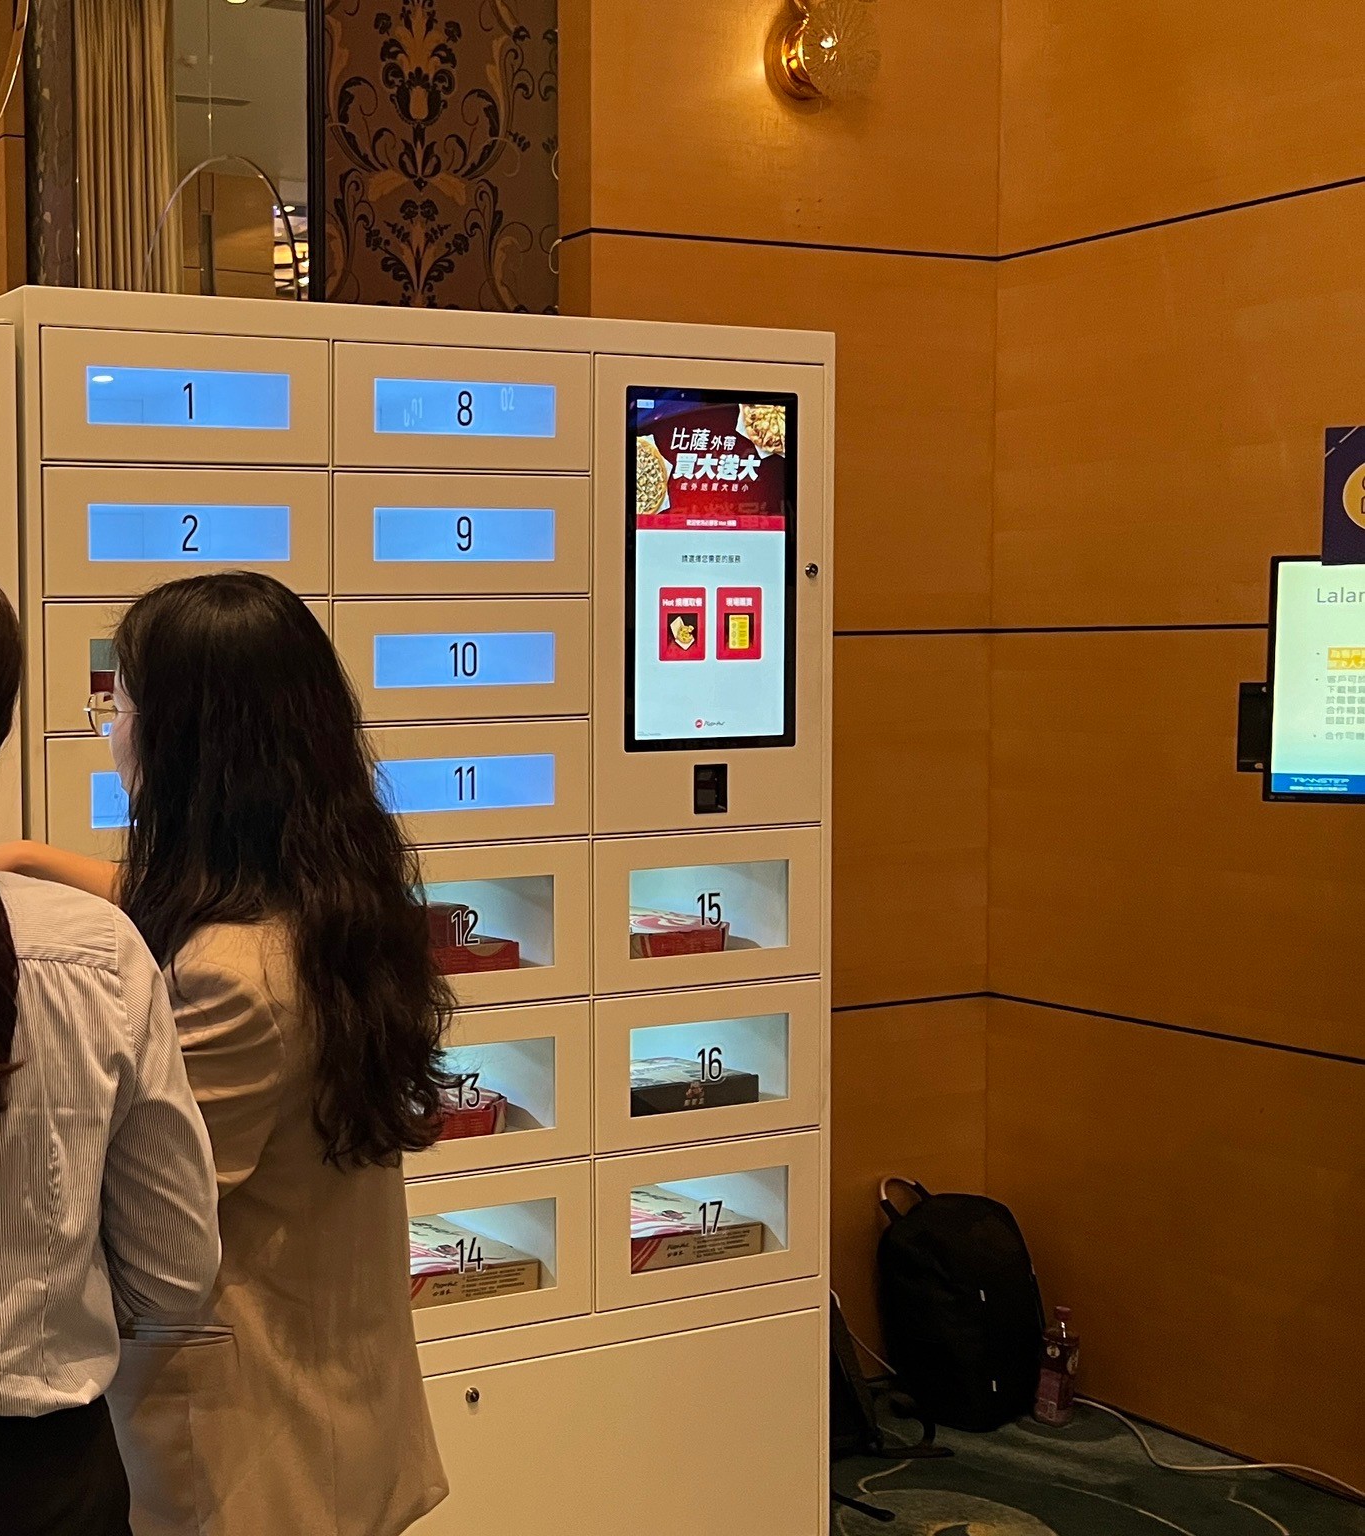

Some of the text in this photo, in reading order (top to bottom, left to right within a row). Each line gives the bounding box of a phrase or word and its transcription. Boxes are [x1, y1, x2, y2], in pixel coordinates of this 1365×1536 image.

[182, 383, 195, 420] 1
[457, 390, 473, 427] 8
[672, 453, 762, 482] 買大送大
[182, 514, 199, 552] 2
[456, 516, 472, 551] 9
[449, 641, 478, 677] 10
[454, 765, 477, 801] 11
[697, 892, 721, 926] 15
[452, 909, 479, 946] 12
[697, 1046, 722, 1081] 16
[457, 1073, 480, 1108] 13
[698, 1200, 723, 1235] 17
[456, 1237, 484, 1272] 14
